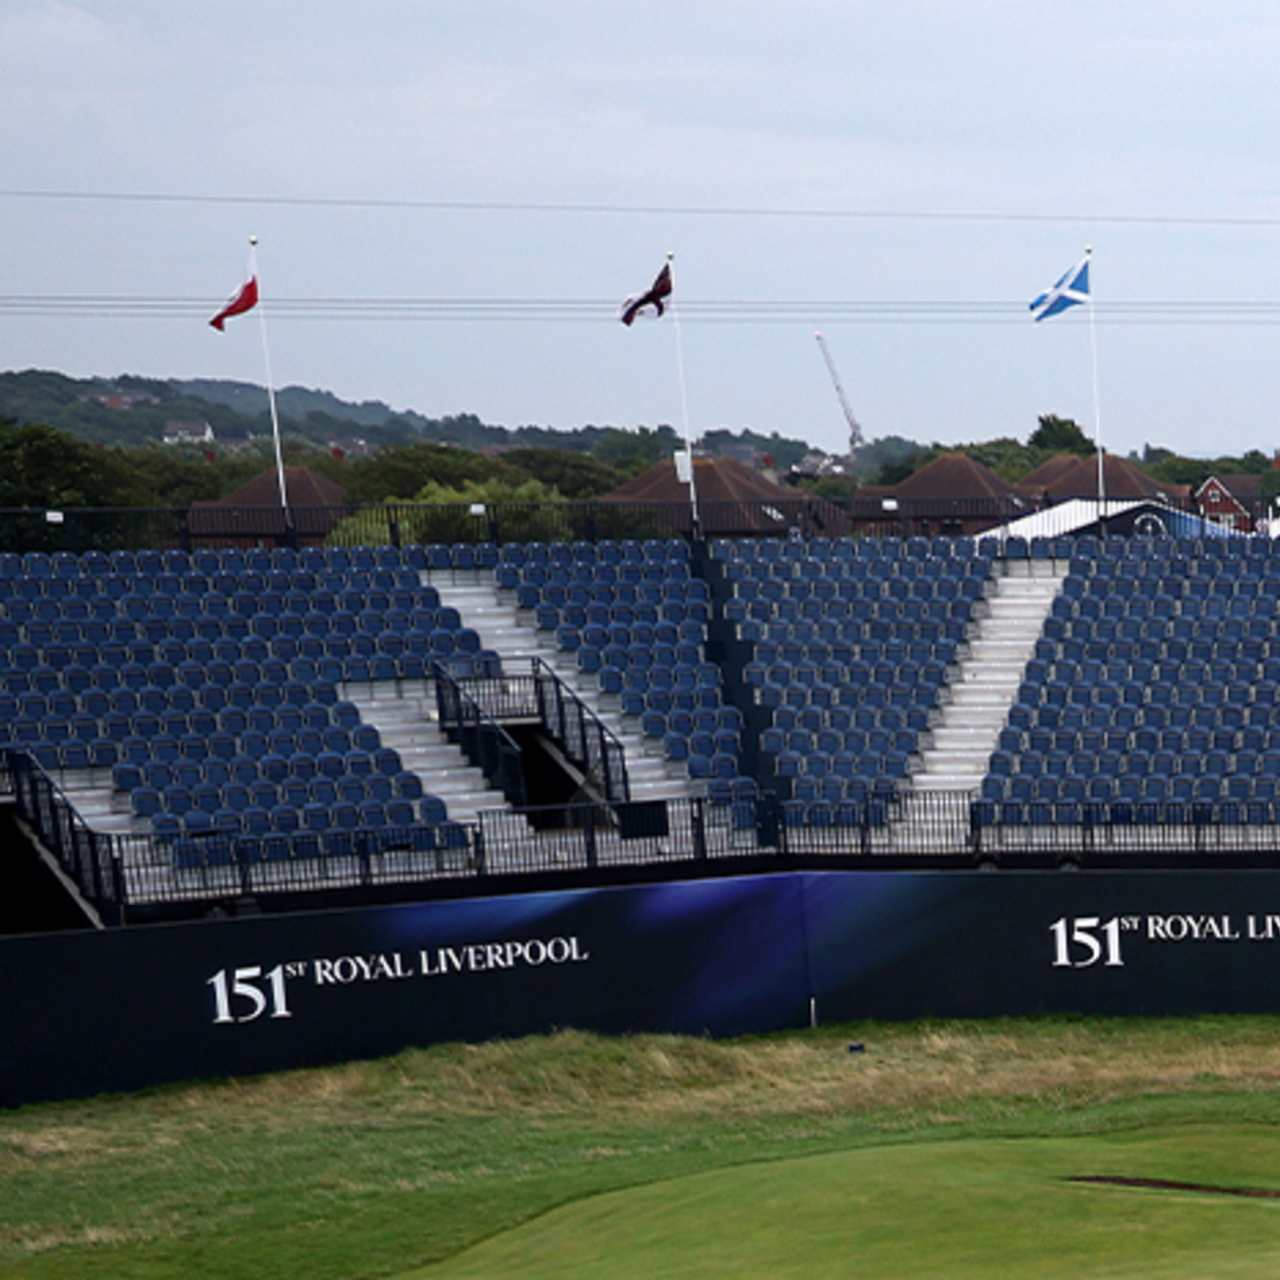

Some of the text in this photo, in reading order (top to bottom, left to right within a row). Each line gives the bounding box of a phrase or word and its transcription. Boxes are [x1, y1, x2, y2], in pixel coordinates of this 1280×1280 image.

[1147, 914, 1240, 939] ROYAL
[314, 952, 413, 985] ROYAL
[419, 936, 590, 976] LIVERPOOL
